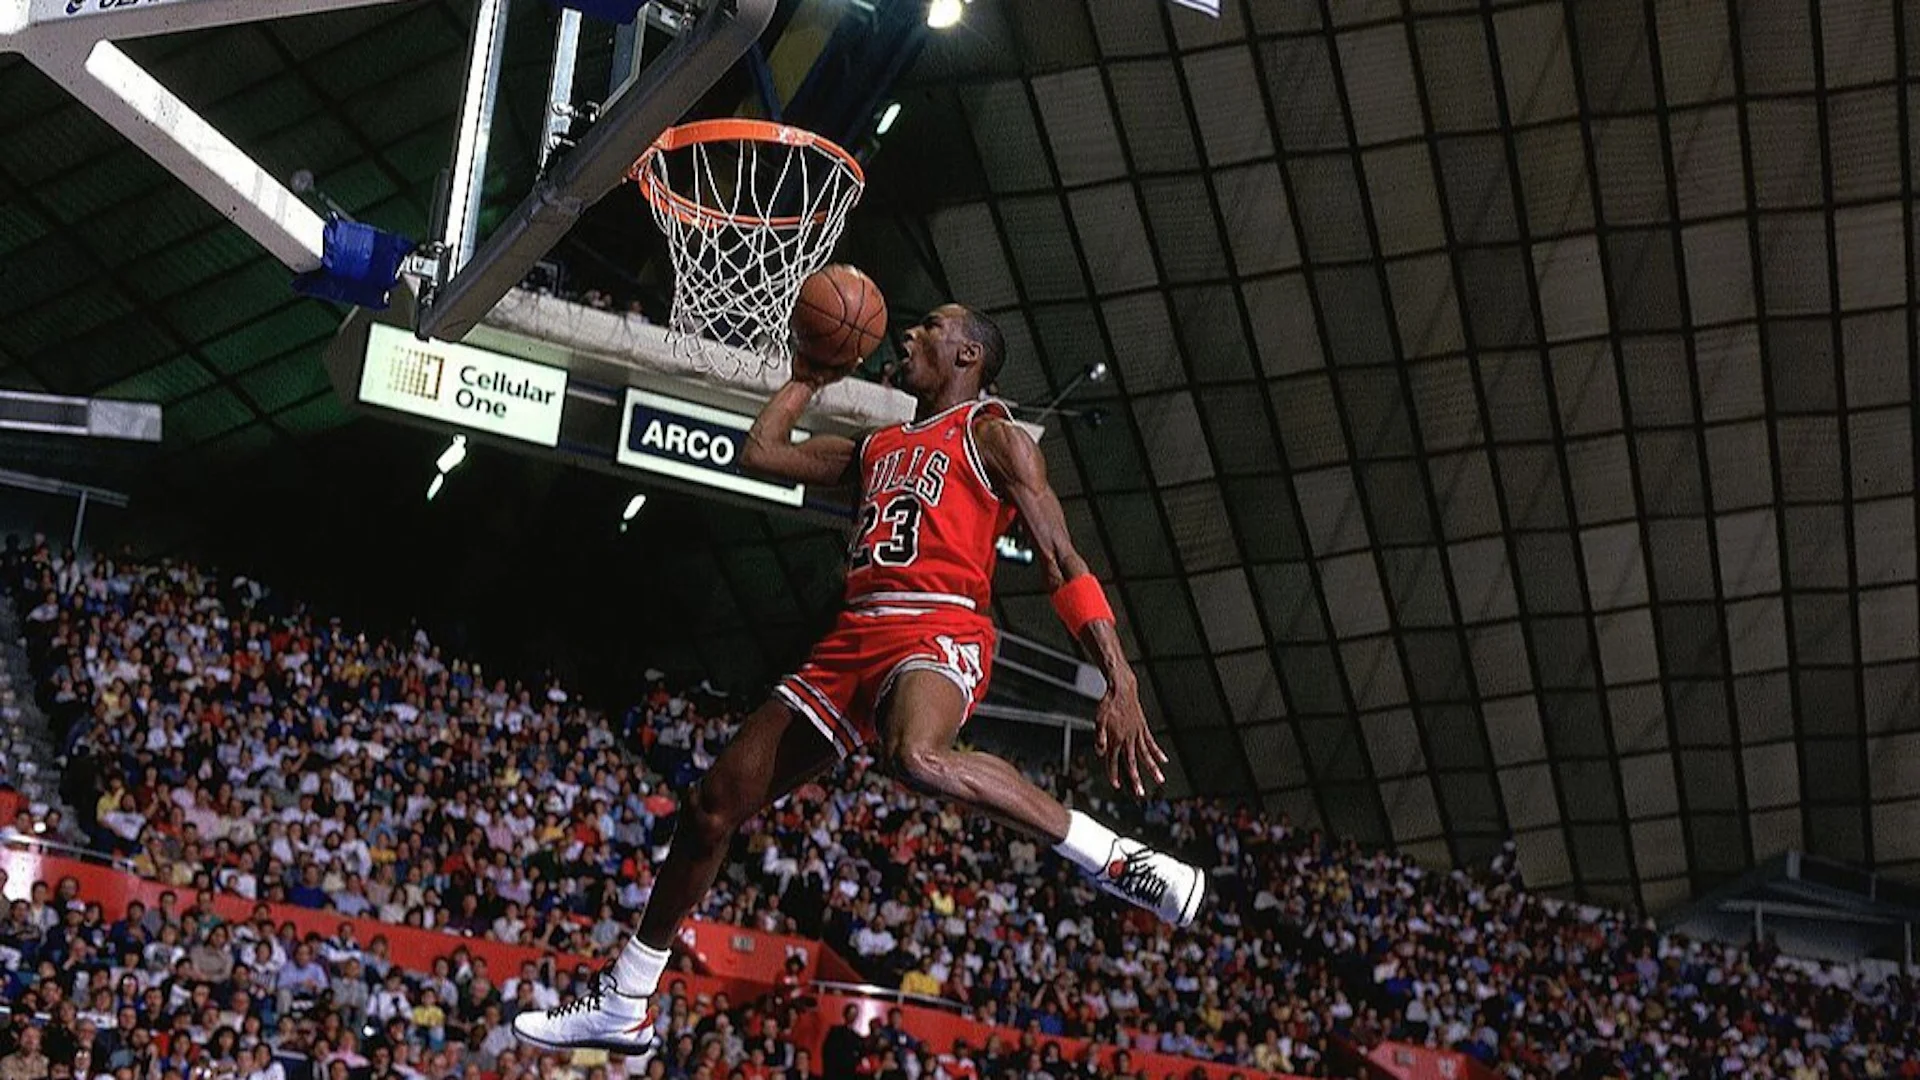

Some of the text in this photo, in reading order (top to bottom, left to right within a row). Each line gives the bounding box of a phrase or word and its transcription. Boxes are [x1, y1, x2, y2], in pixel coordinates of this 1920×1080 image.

[456, 388, 507, 418] One
[460, 365, 556, 405] Cellular
[641, 418, 735, 466] ARCO
[865, 445, 950, 508] ULLS
[848, 493, 922, 576] 23
